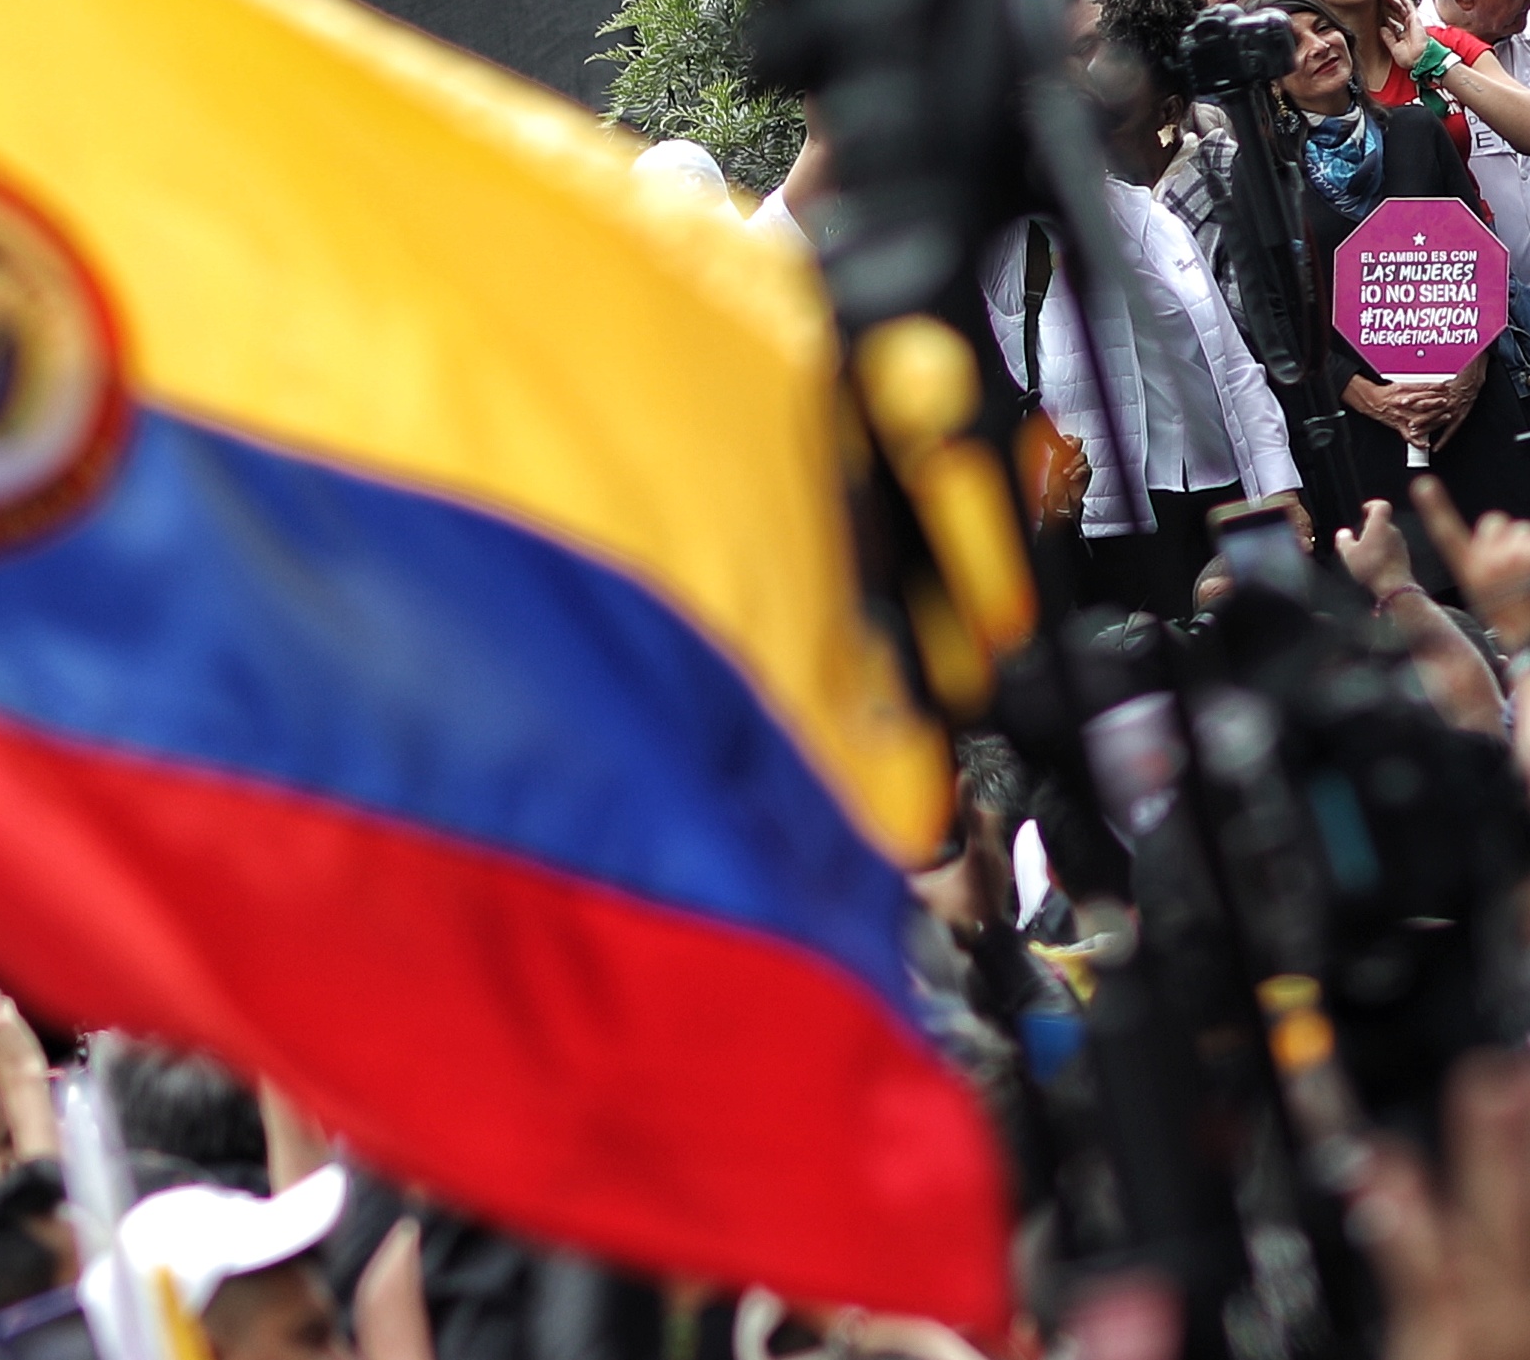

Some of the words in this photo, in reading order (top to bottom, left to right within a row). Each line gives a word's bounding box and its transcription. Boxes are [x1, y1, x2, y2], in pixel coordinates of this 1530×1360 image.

[1360, 252, 1376, 263] EL
[1379, 251, 1428, 263] CAMBIO
[1431, 250, 1448, 262] ES
[1450, 250, 1478, 262] CON
[1362, 264, 1396, 283] LAS
[1399, 263, 1475, 284] MUJERES
[1385, 285, 1415, 303] NO
[1360, 303, 1478, 330] #TRANSICIÓN
